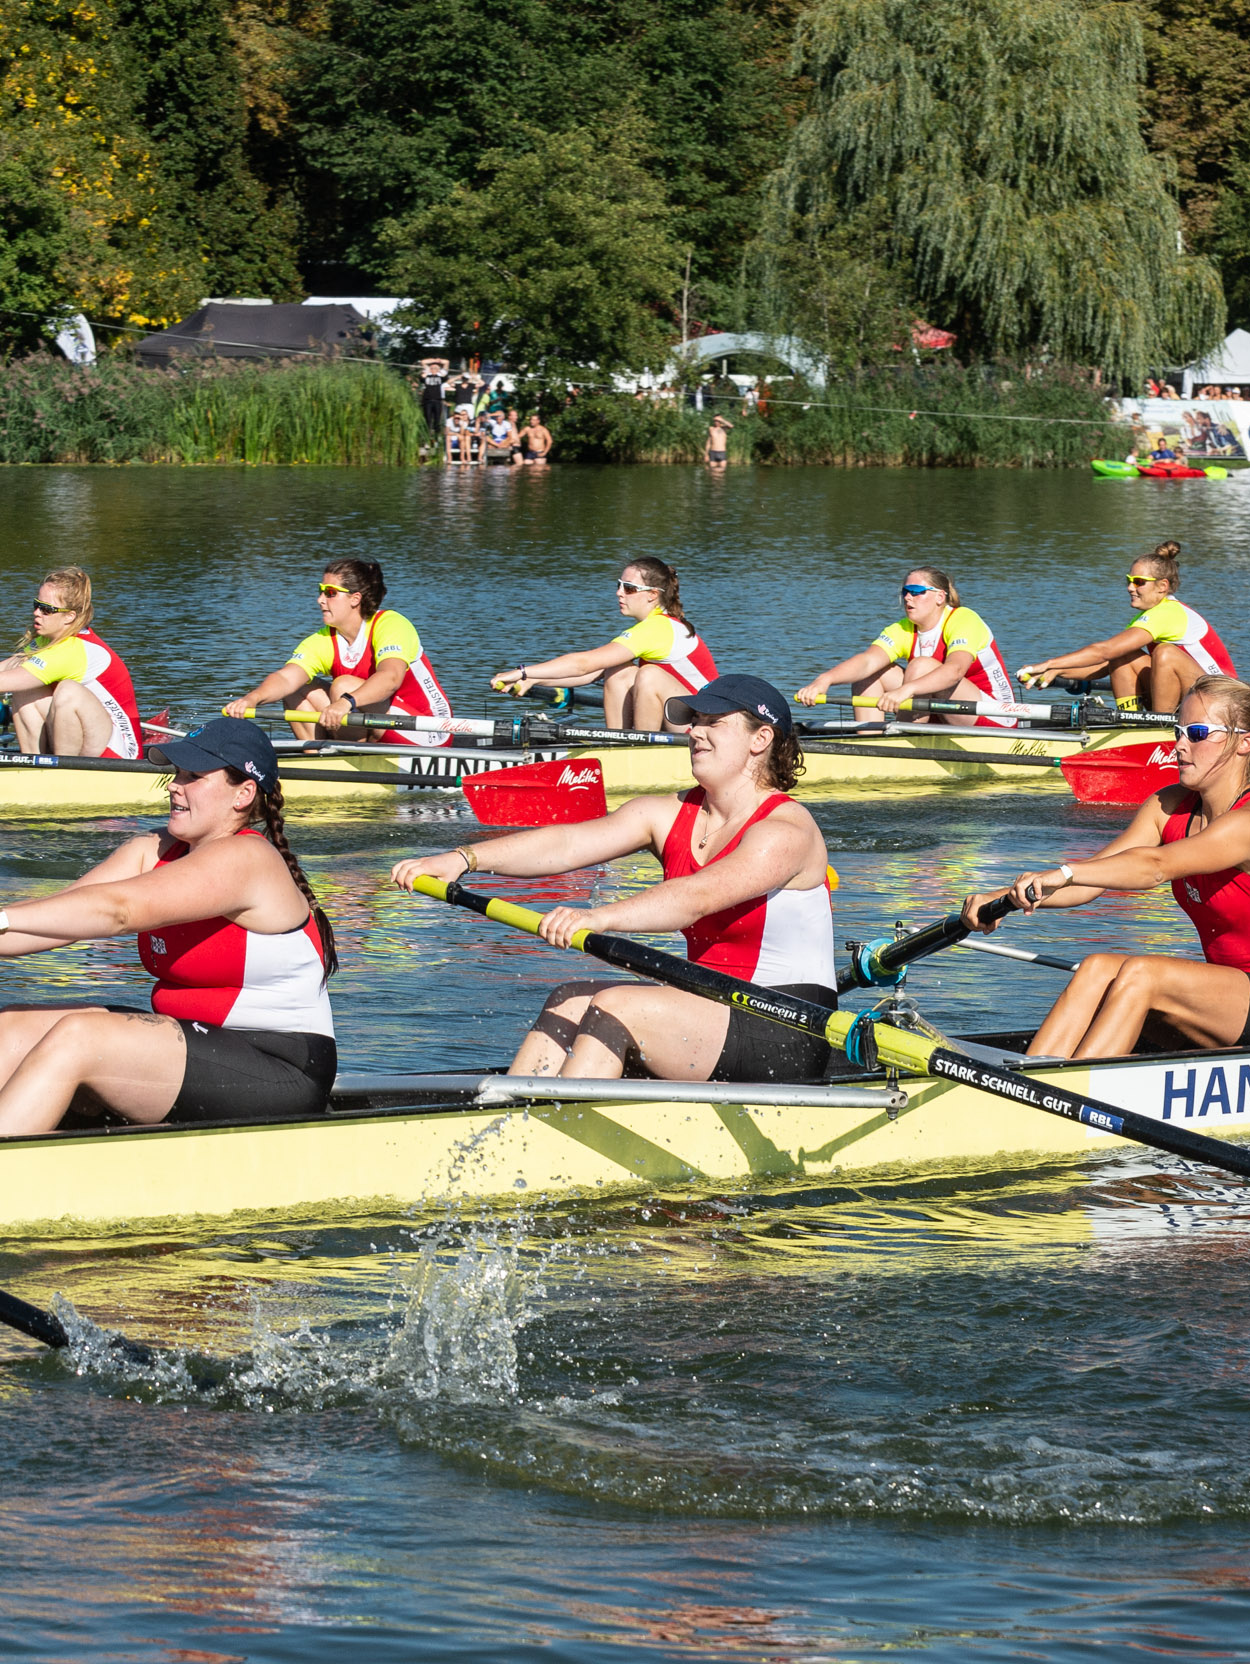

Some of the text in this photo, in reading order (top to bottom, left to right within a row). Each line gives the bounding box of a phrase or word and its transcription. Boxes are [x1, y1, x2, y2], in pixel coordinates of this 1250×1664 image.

[383, 645, 401, 653] RBL
[565, 729, 592, 737] STARK.
[592, 730, 627, 740] SCHNELL.
[557, 765, 599, 787] Melitta
[749, 999, 797, 1020] concept
[799, 1014, 808, 1023] 2
[935, 1059, 979, 1084] STARK.
[981, 1074, 1041, 1105] SCHNELL.
[1043, 1096, 1073, 1116] GUT.
[1089, 1111, 1114, 1128] RBL
